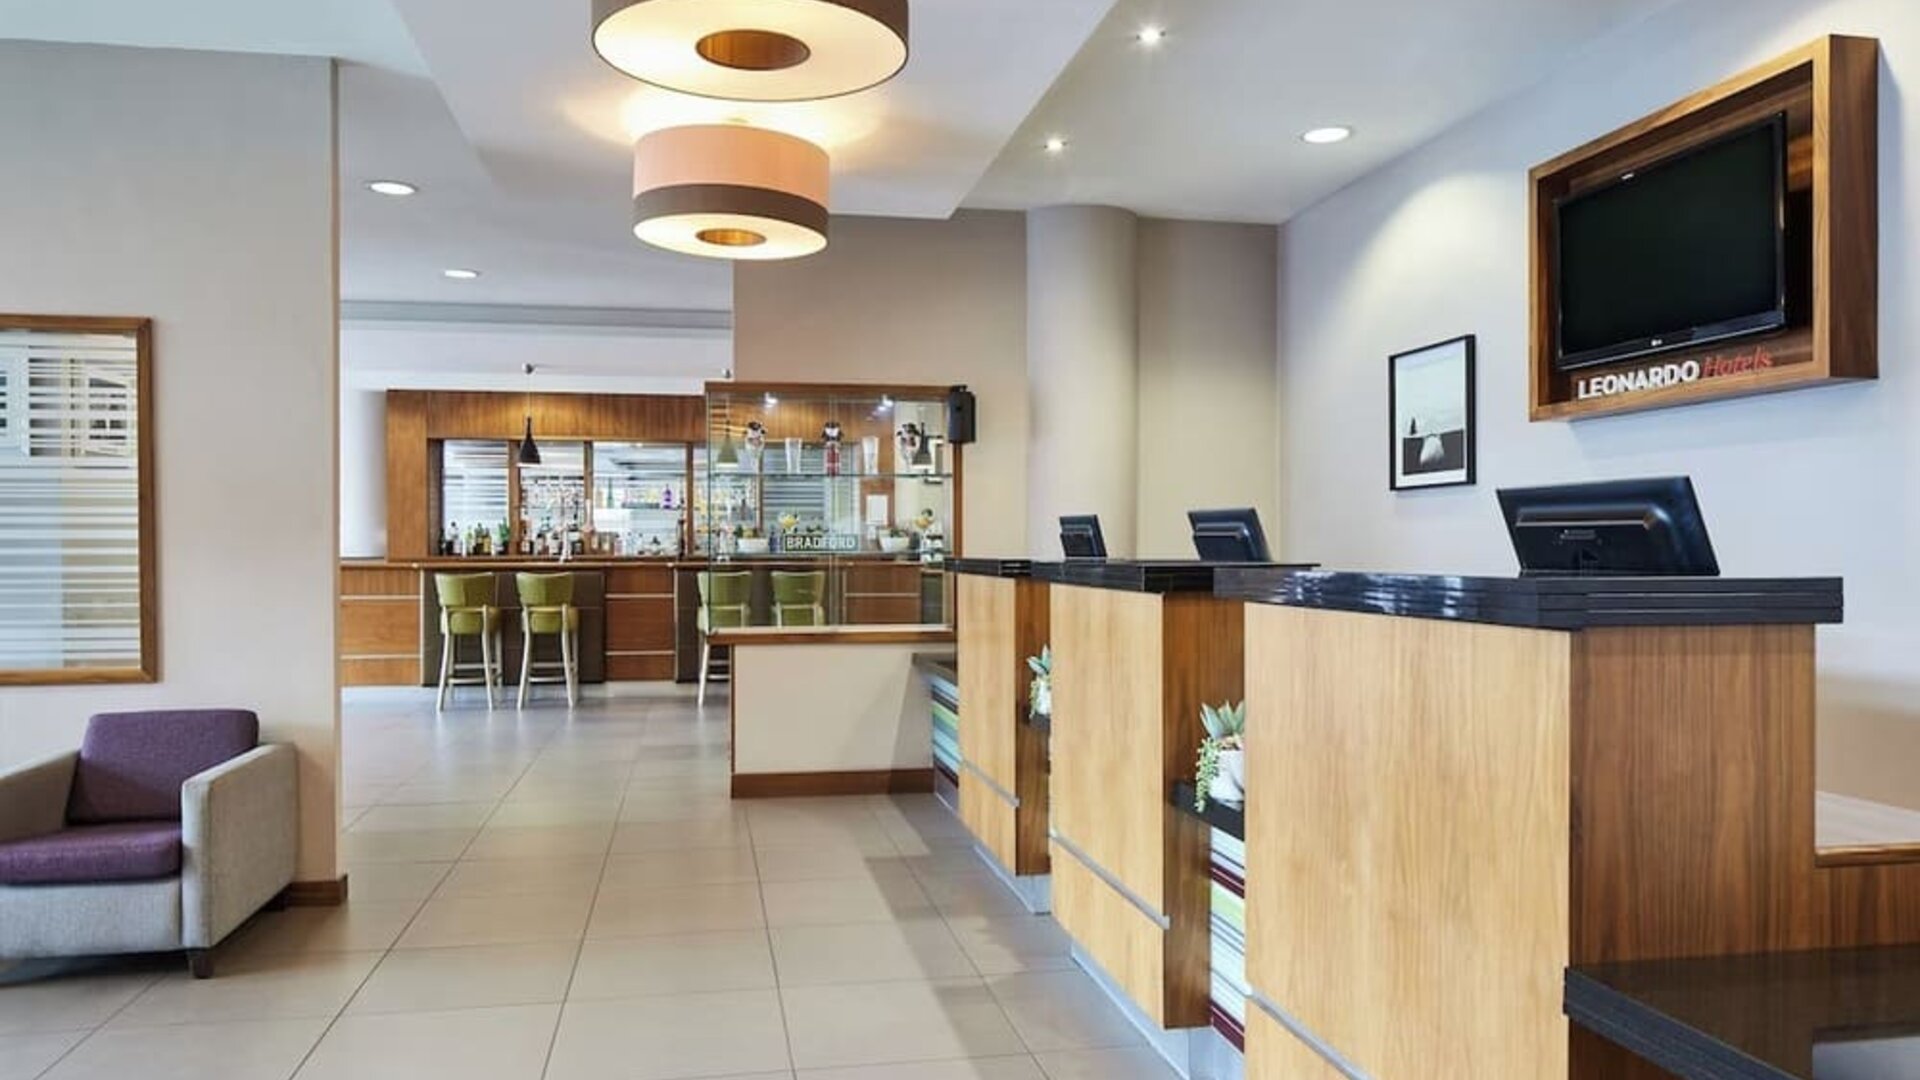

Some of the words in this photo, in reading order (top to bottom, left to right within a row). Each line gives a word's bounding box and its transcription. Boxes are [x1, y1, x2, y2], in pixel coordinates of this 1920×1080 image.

[1577, 360, 1700, 399] LEONARDO
[1702, 347, 1773, 379] Hotels
[786, 535, 856, 550] BRADFORD
